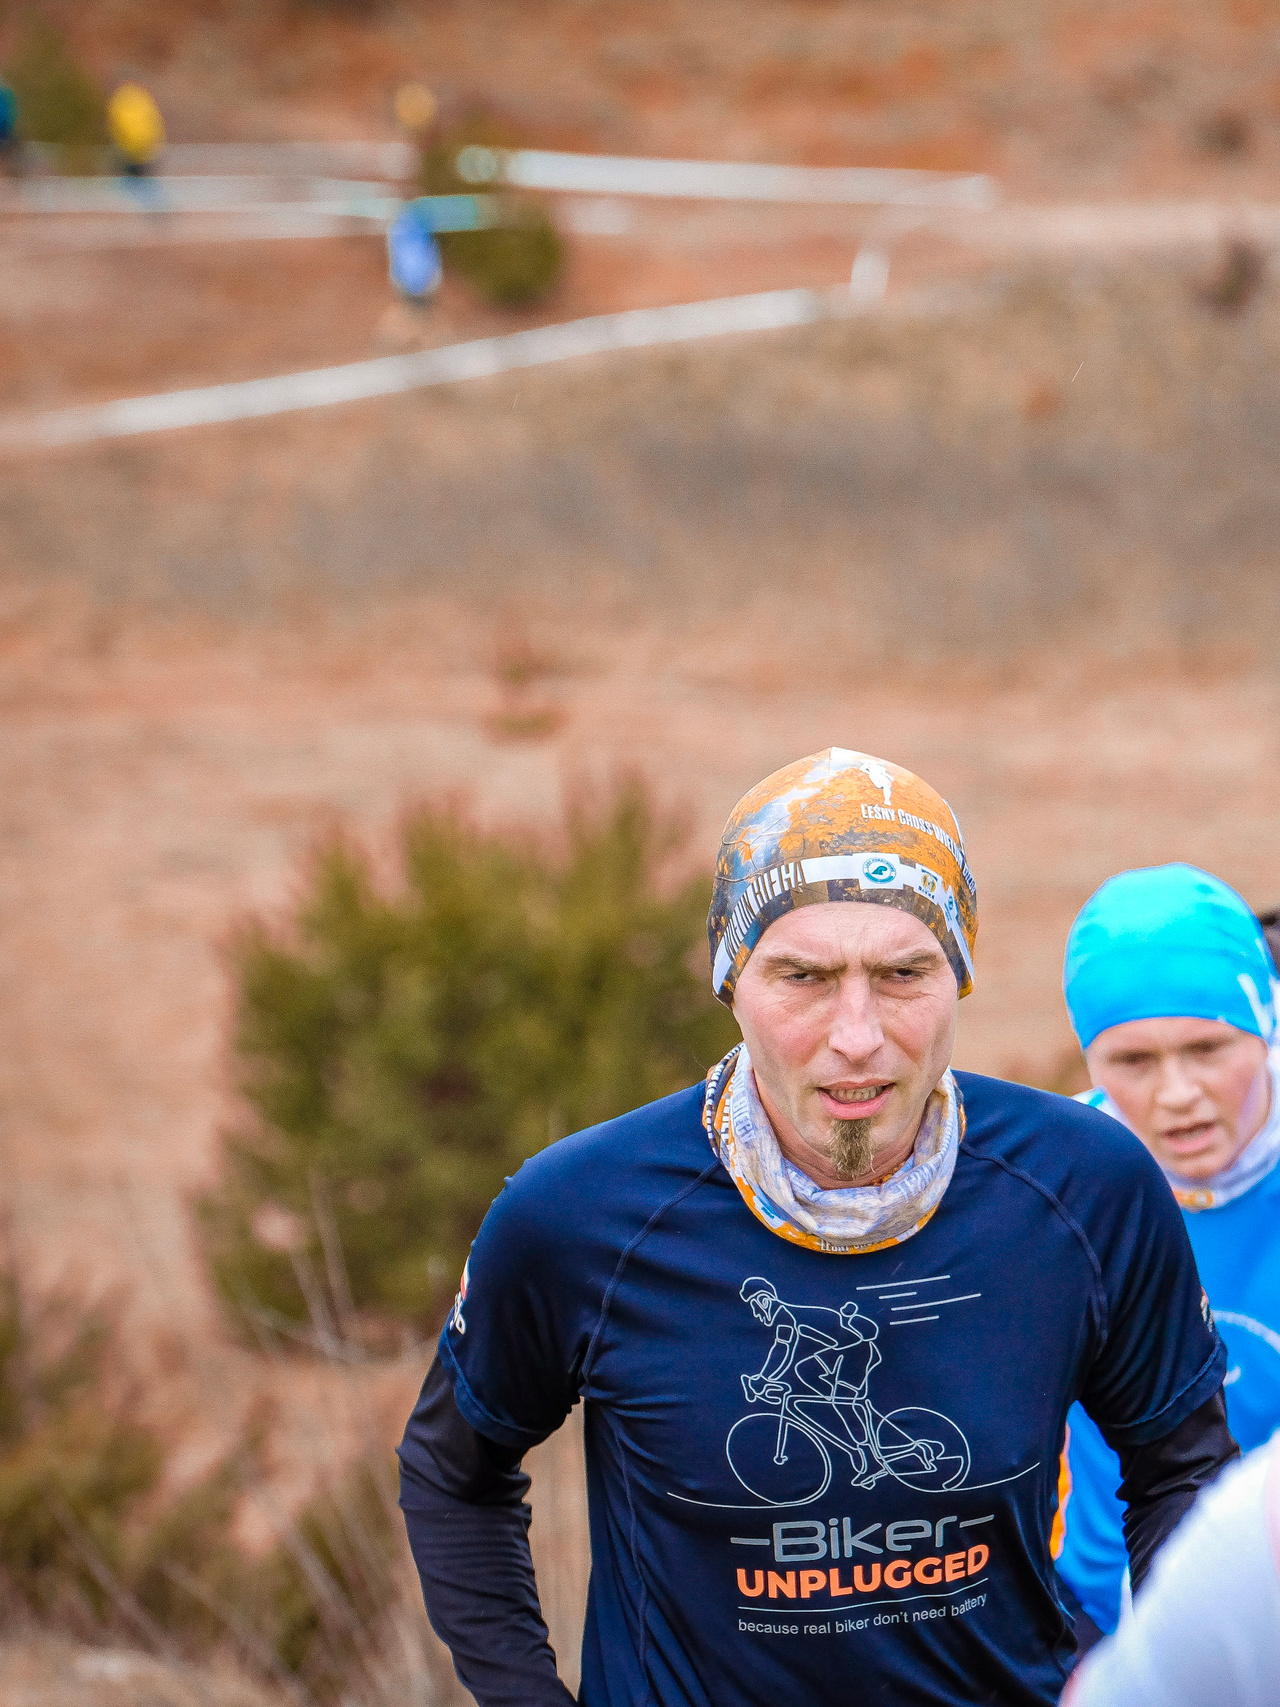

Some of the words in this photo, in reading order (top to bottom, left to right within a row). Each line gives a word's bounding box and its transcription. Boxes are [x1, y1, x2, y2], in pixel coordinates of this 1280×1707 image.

[898, 808, 933, 835] CROSS
[773, 1516, 957, 1562] Biker
[736, 1544, 990, 1598] UNPLUGGED
[738, 1619, 799, 1634] because
[803, 1617, 831, 1634] real
[835, 1616, 869, 1634] biker
[873, 1610, 908, 1629] don't
[912, 1606, 946, 1622] need
[951, 1593, 987, 1617] battery
